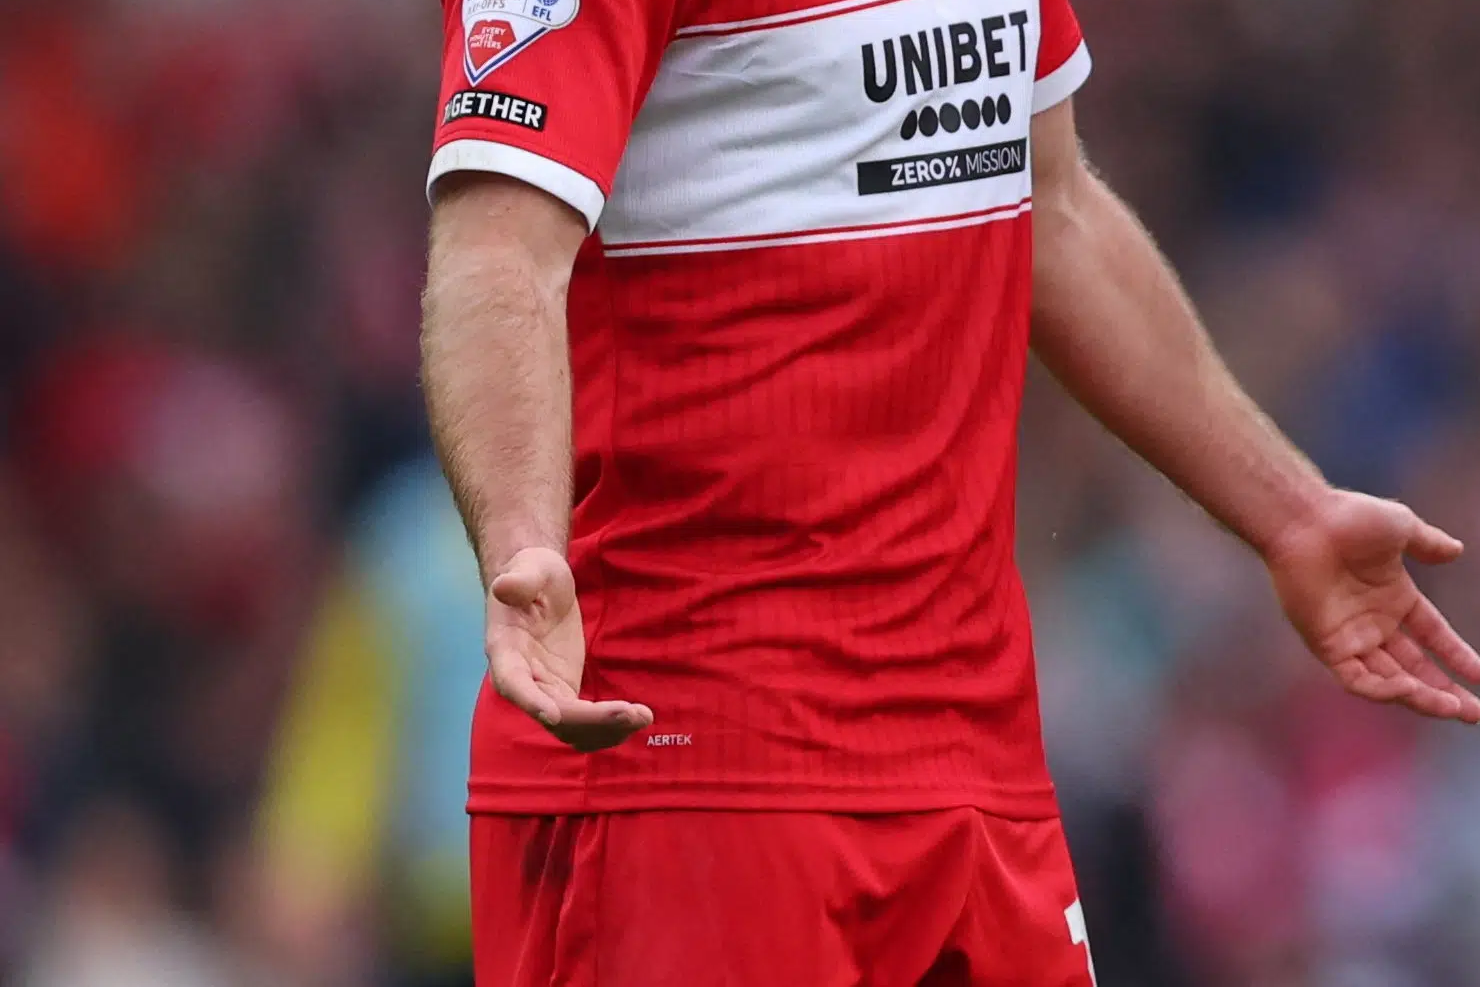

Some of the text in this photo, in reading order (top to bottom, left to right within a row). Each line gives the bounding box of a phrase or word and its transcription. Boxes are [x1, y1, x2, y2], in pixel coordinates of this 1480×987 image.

[532, 6, 552, 21] EFL
[861, 10, 1028, 103] UNIBET
[891, 145, 1021, 186] ZERO% MISSION
[647, 733, 692, 746] AERTEK
